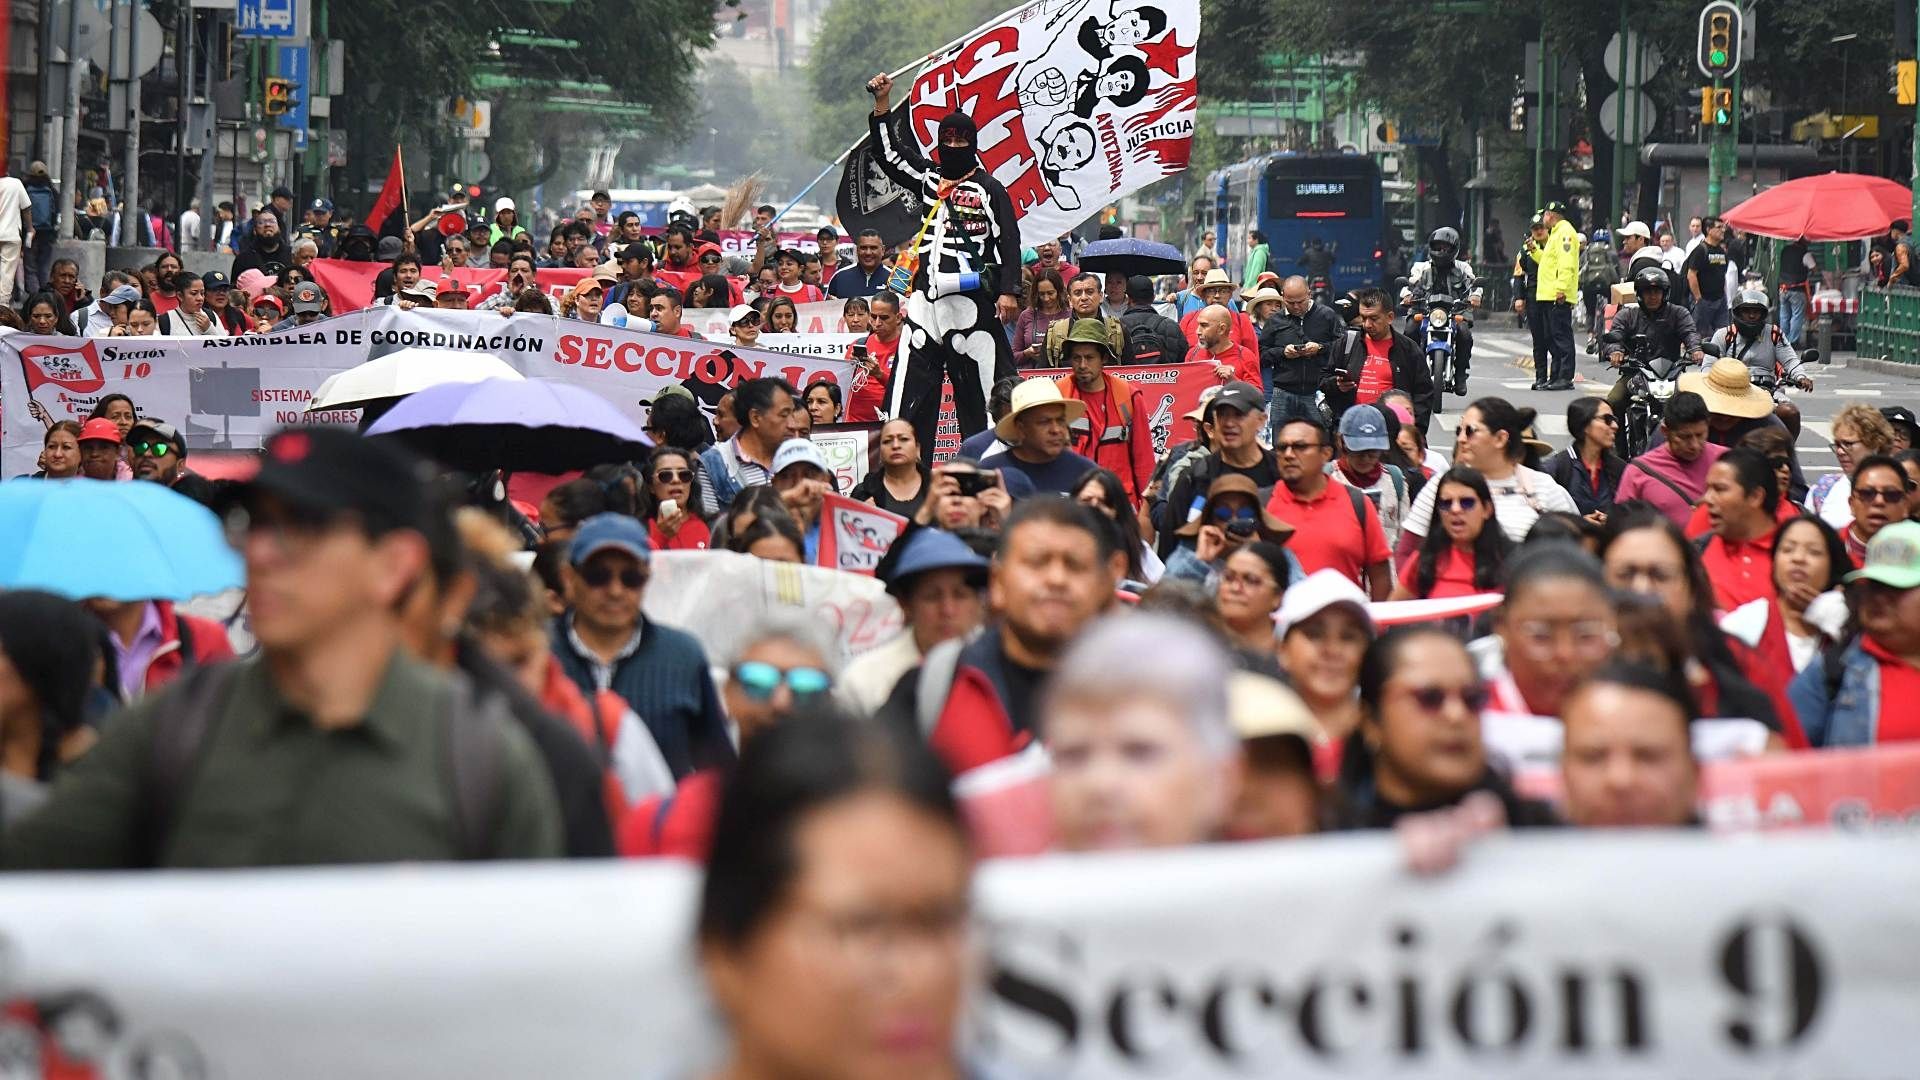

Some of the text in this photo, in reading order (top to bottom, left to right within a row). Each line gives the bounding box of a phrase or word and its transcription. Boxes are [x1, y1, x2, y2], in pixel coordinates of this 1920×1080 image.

[1125, 119, 1194, 153] JUSTICIA
[203, 330, 544, 352] ASAMBLEA DE COORDINACIÓN
[555, 334, 768, 389] SECCIÓN
[123, 363, 151, 380] 10
[57, 392, 100, 405] Asambl
[251, 390, 312, 403] SISTEMA
[276, 411, 358, 424] NO AFORES
[985, 908, 1828, 1062] Sección 9
